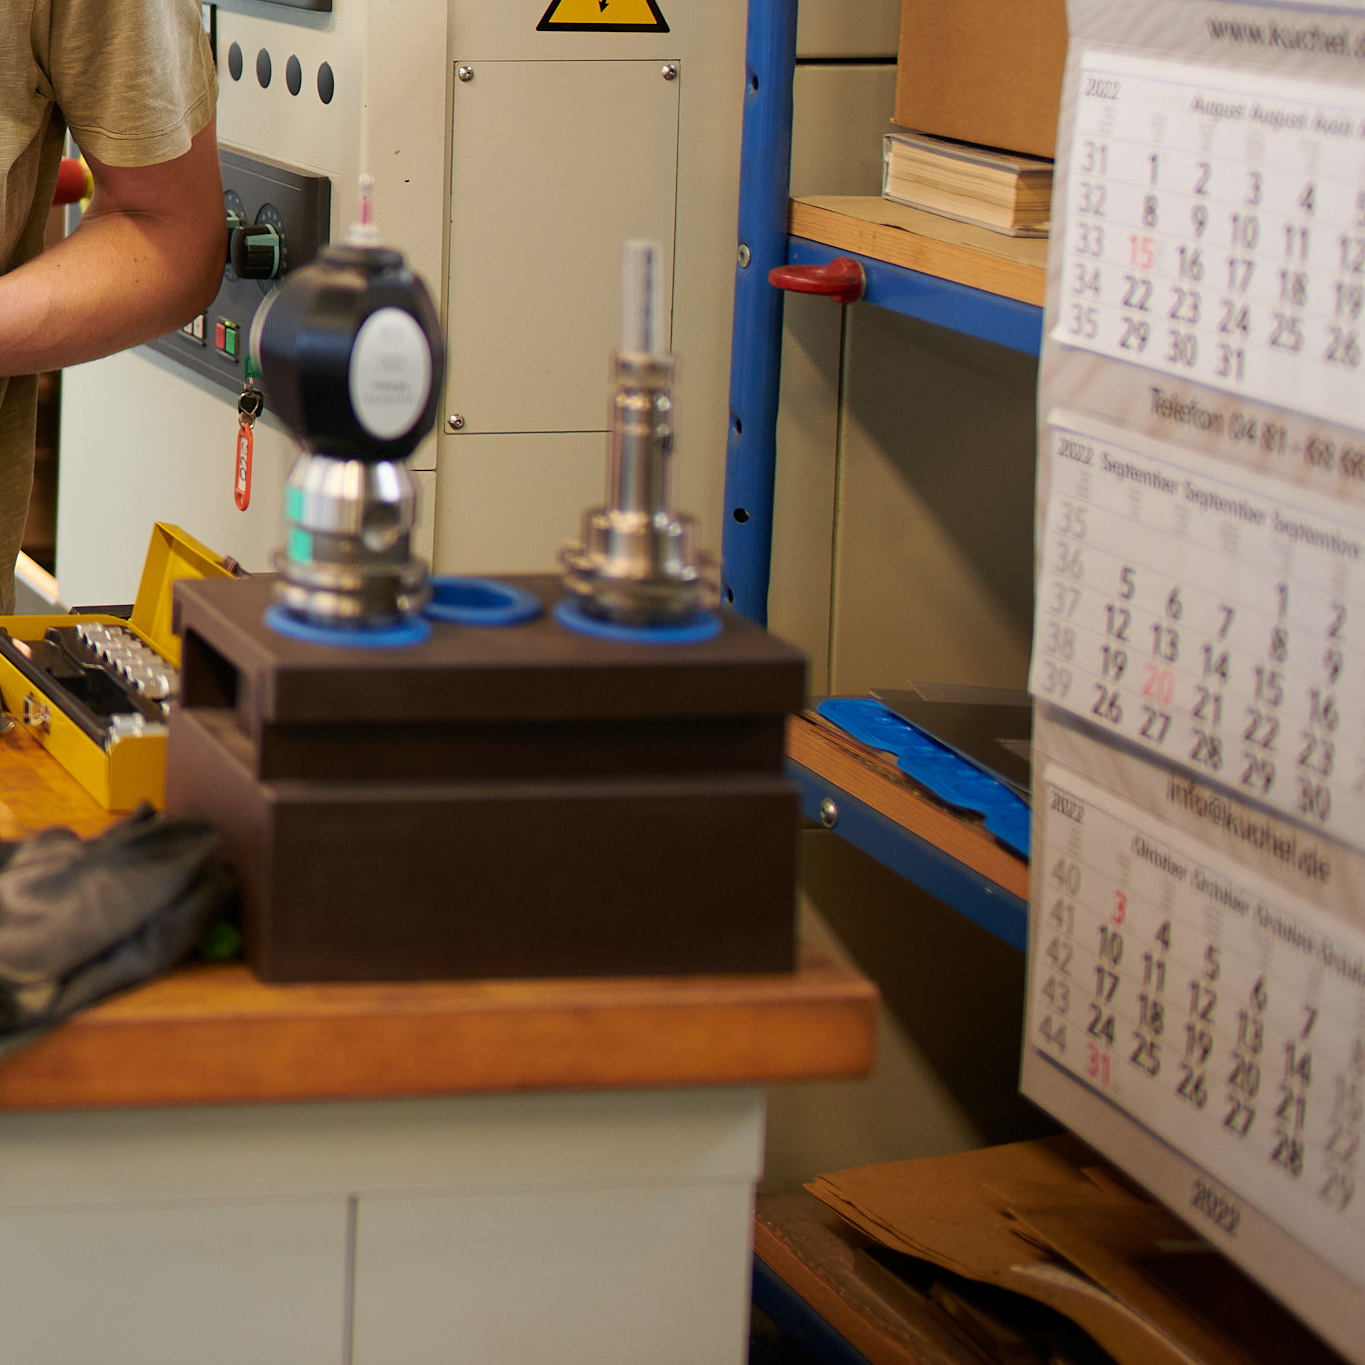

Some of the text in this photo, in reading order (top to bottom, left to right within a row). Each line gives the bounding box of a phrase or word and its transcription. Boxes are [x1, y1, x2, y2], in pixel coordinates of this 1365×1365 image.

[1084, 78, 1121, 101] 2022
[1078, 182, 1106, 215] 32
[1143, 195, 1158, 228] 8
[1192, 205, 1207, 238] 9
[1230, 213, 1260, 250] 10
[1285, 225, 1310, 260] 11
[1081, 141, 1316, 214] 31 1 2 3 4
[1072, 263, 1360, 368] 34 22 23 24 25 26
[1075, 222, 1363, 321] 33 15 16 17 18 19
[1069, 303, 1245, 381] 35 29 30 31
[1150, 386, 1224, 438] Telefon
[1058, 438, 1094, 465] 2022
[1101, 451, 1178, 494] September
[1185, 480, 1267, 526] September
[1054, 541, 1343, 686] 36 5 6 7 8 9
[1059, 501, 1347, 641] 35 1 2
[1045, 621, 1076, 661] 38
[1099, 644, 1128, 681] 19
[1144, 662, 1175, 705] 20
[1193, 686, 1224, 726] 21
[1244, 709, 1280, 753] 22
[1050, 581, 1339, 733] 37 12 13 14 15 16
[1040, 661, 1073, 699] 39
[1092, 684, 1124, 724] 26
[1140, 705, 1173, 744] 27
[1191, 729, 1223, 771] 28
[1242, 754, 1276, 795] 29
[1049, 898, 1313, 1088] 41 10 11 12 13 14
[1051, 857, 1318, 1040] 40 3 4 5 6 7
[1039, 1014, 1110, 1087] 44 31
[1042, 975, 1071, 1015] 43
[1087, 1003, 1116, 1046] 24
[1130, 1033, 1162, 1077] 25
[1176, 1064, 1208, 1110] 26
[1223, 1096, 1257, 1139] 27
[1272, 1132, 1305, 1178] 28
[1046, 939, 1074, 977] 42
[1095, 965, 1121, 1004] 17
[1138, 994, 1165, 1037] 18
[1185, 1022, 1213, 1065] 19
[1229, 1054, 1261, 1099] 20
[1276, 1086, 1307, 1131] 21
